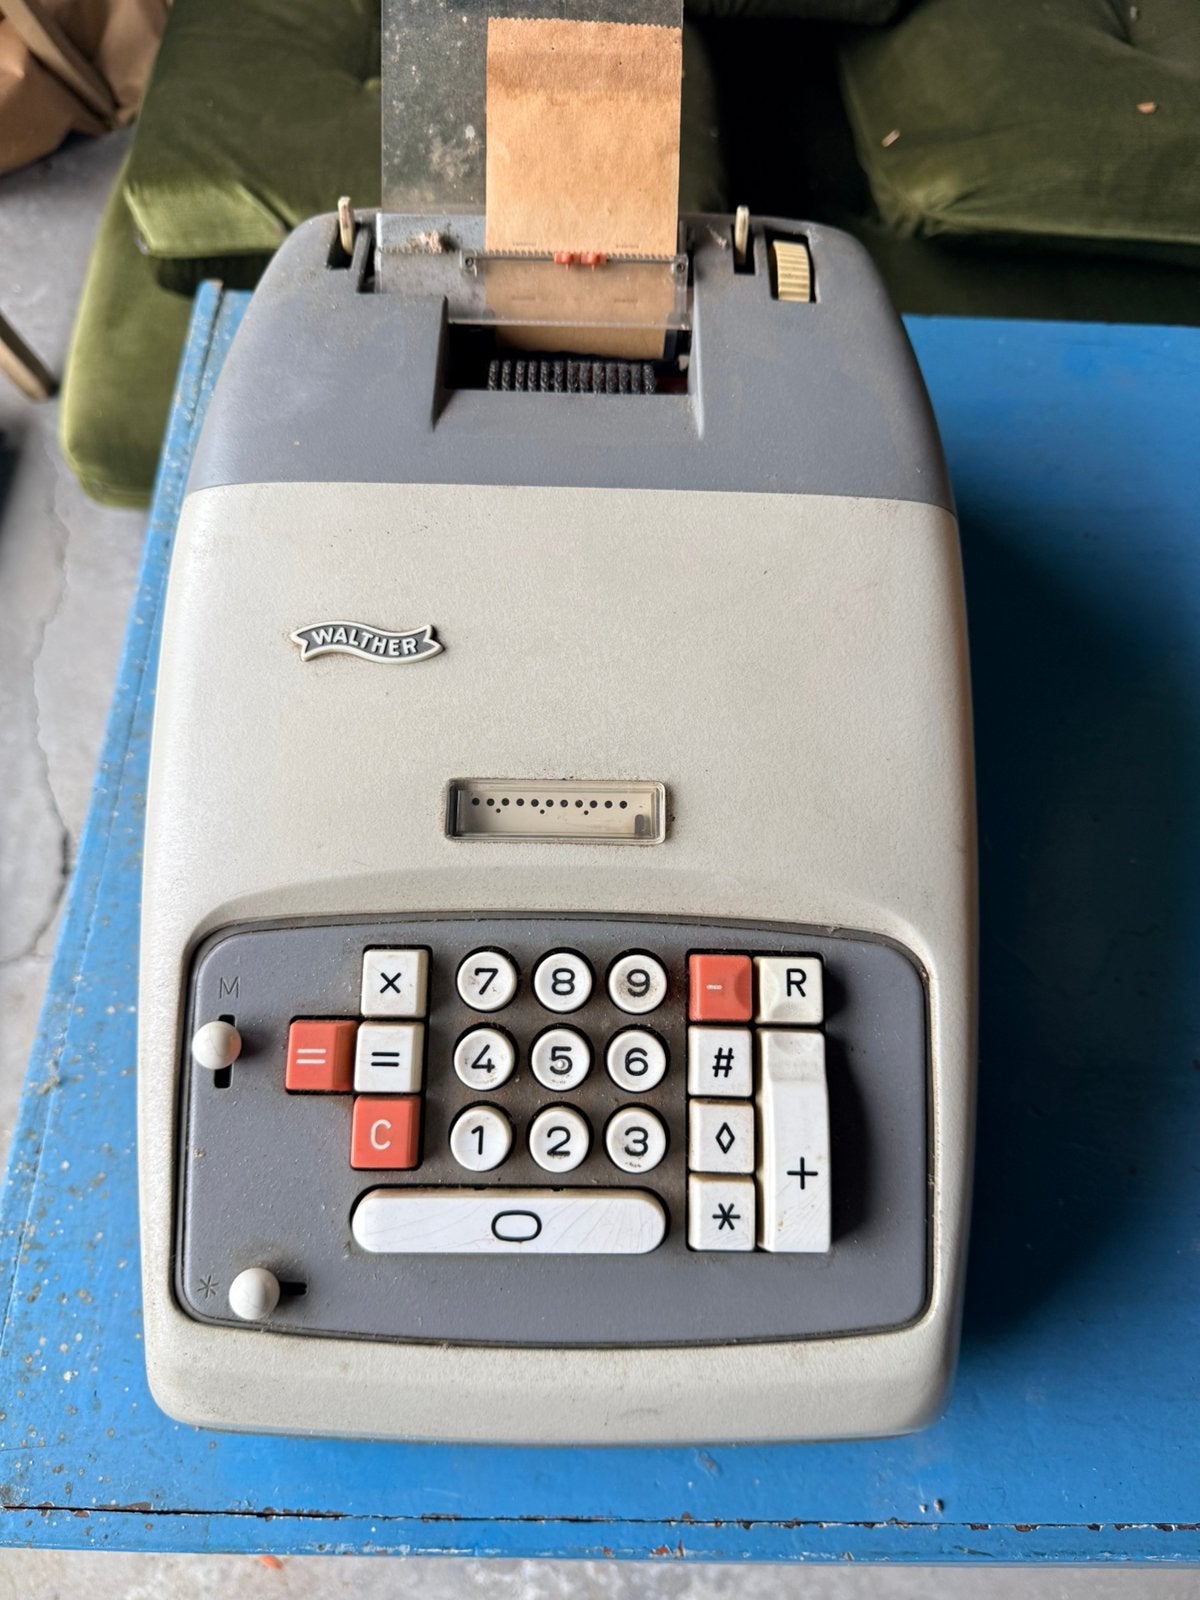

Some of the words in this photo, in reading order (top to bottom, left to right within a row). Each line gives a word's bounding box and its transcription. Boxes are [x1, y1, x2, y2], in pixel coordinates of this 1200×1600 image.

[311, 627, 418, 656] WALTHER
[219, 976, 240, 999] M
[474, 966, 499, 996] 7
[551, 967, 576, 996] 8
[626, 968, 651, 997] 9
[786, 968, 807, 998] R
[470, 1044, 496, 1074] 4
[549, 1045, 574, 1076] 5
[624, 1047, 649, 1077] 6
[369, 1118, 392, 1151] C
[470, 1125, 485, 1156] 1
[546, 1125, 572, 1157] 2
[624, 1126, 650, 1157] 3
